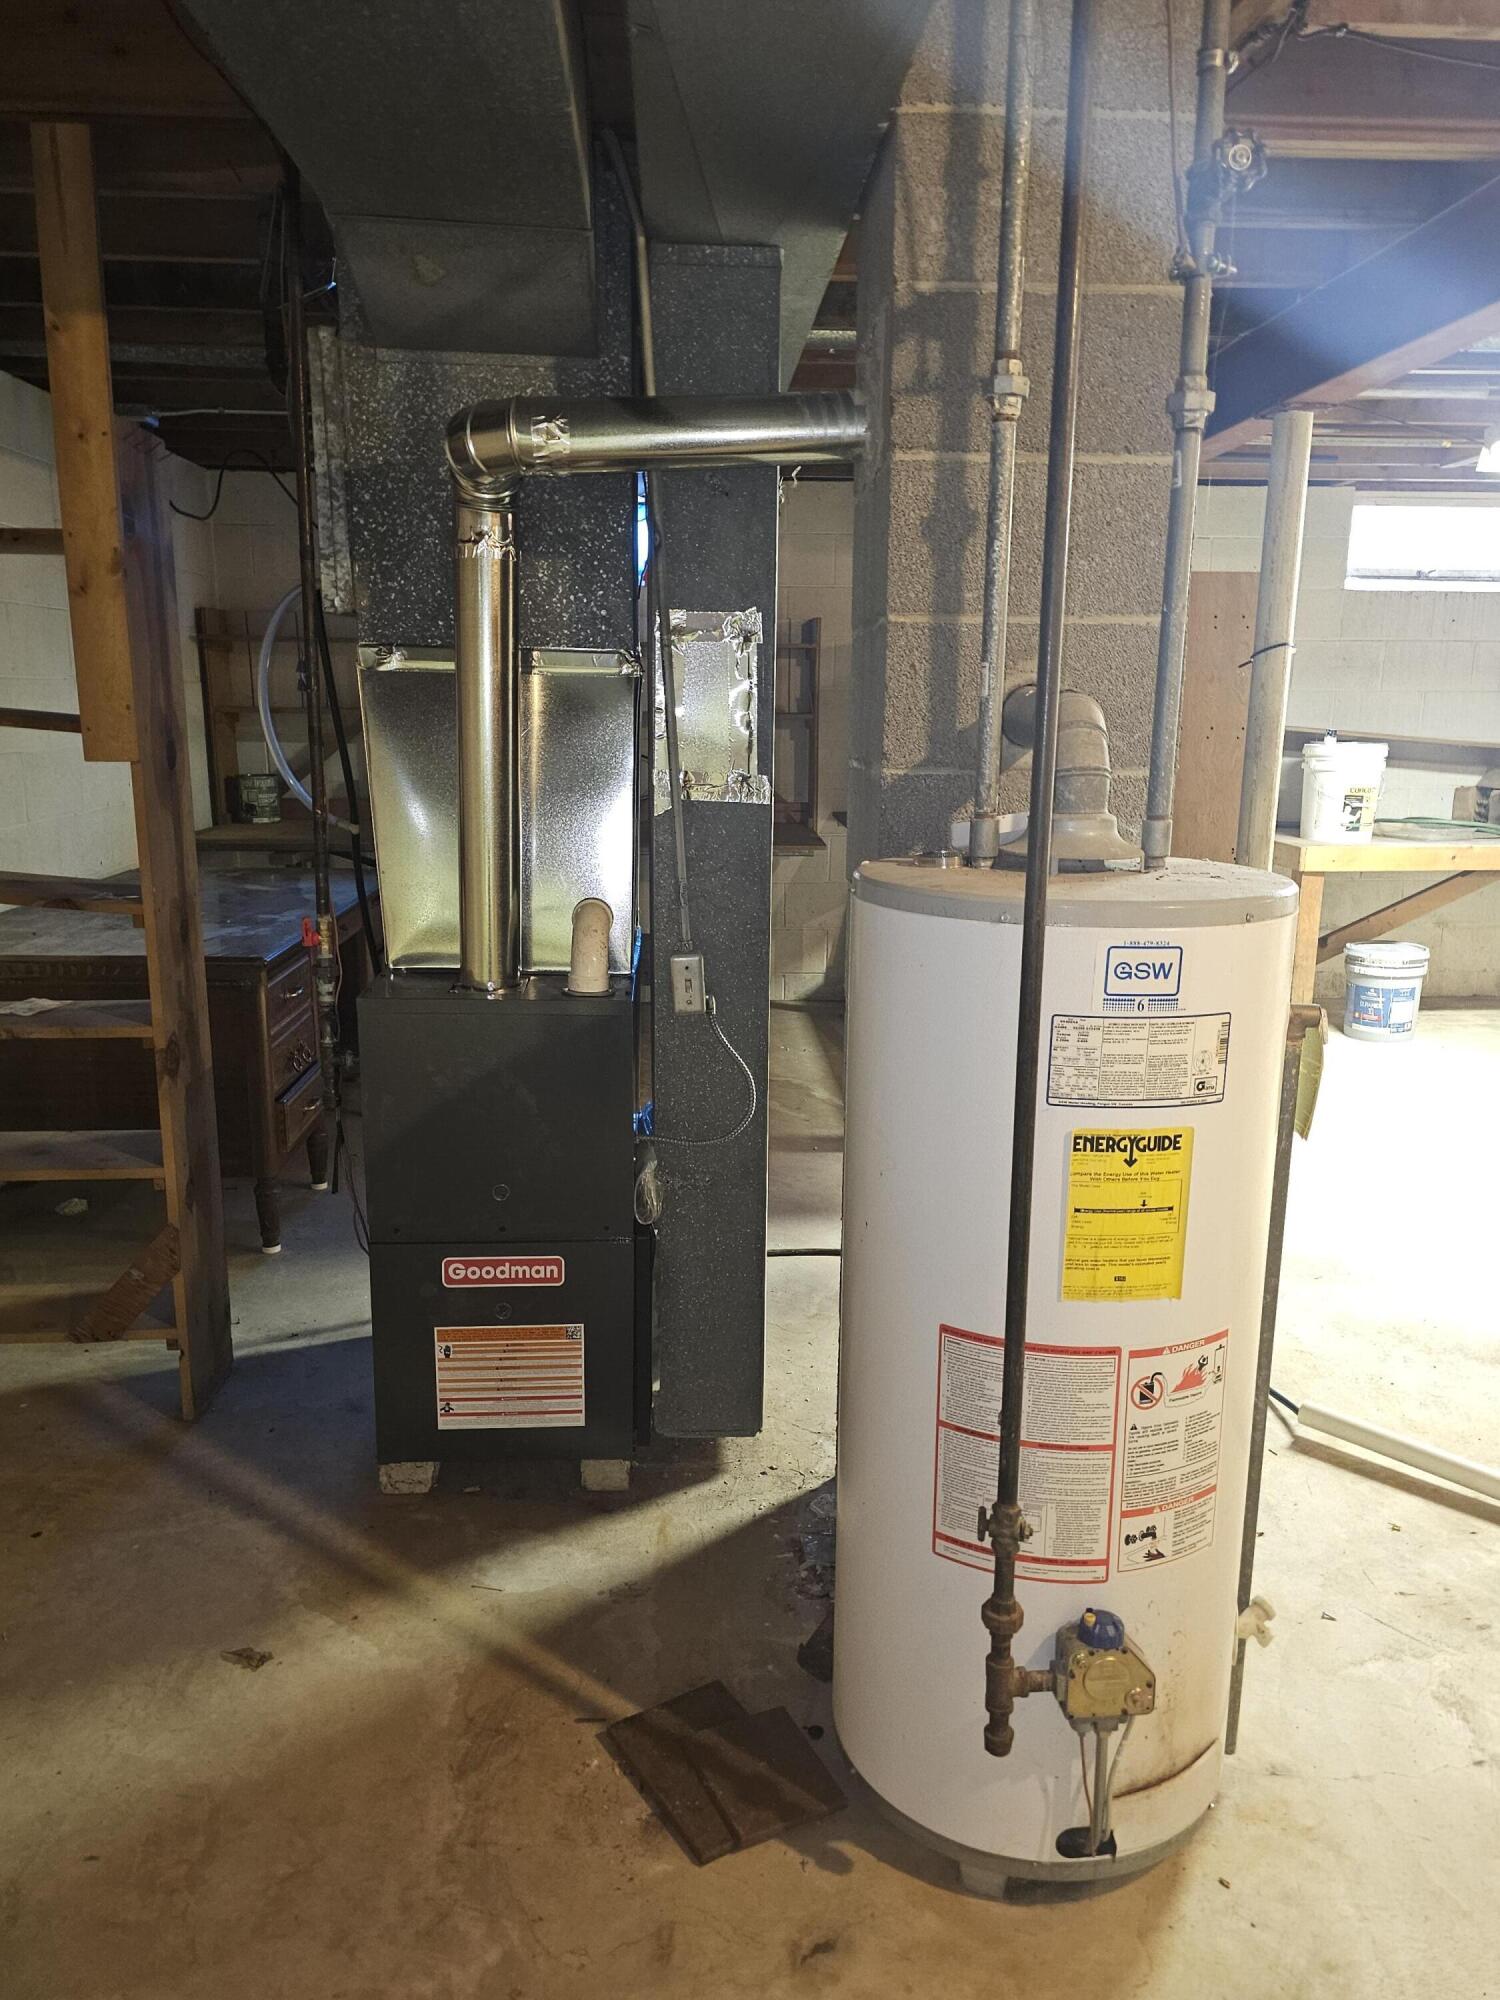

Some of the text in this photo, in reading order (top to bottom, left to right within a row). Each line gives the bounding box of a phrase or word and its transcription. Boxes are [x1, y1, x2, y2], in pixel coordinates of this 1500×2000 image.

[1114, 962, 1173, 980] GSW
[1137, 998, 1145, 1013] 6
[1073, 1134, 1183, 1153] ENERGYGUIDE
[448, 1262, 559, 1280] Goodman
[1171, 1339, 1205, 1353] DANGER
[1161, 1496, 1195, 1511] DANGER
